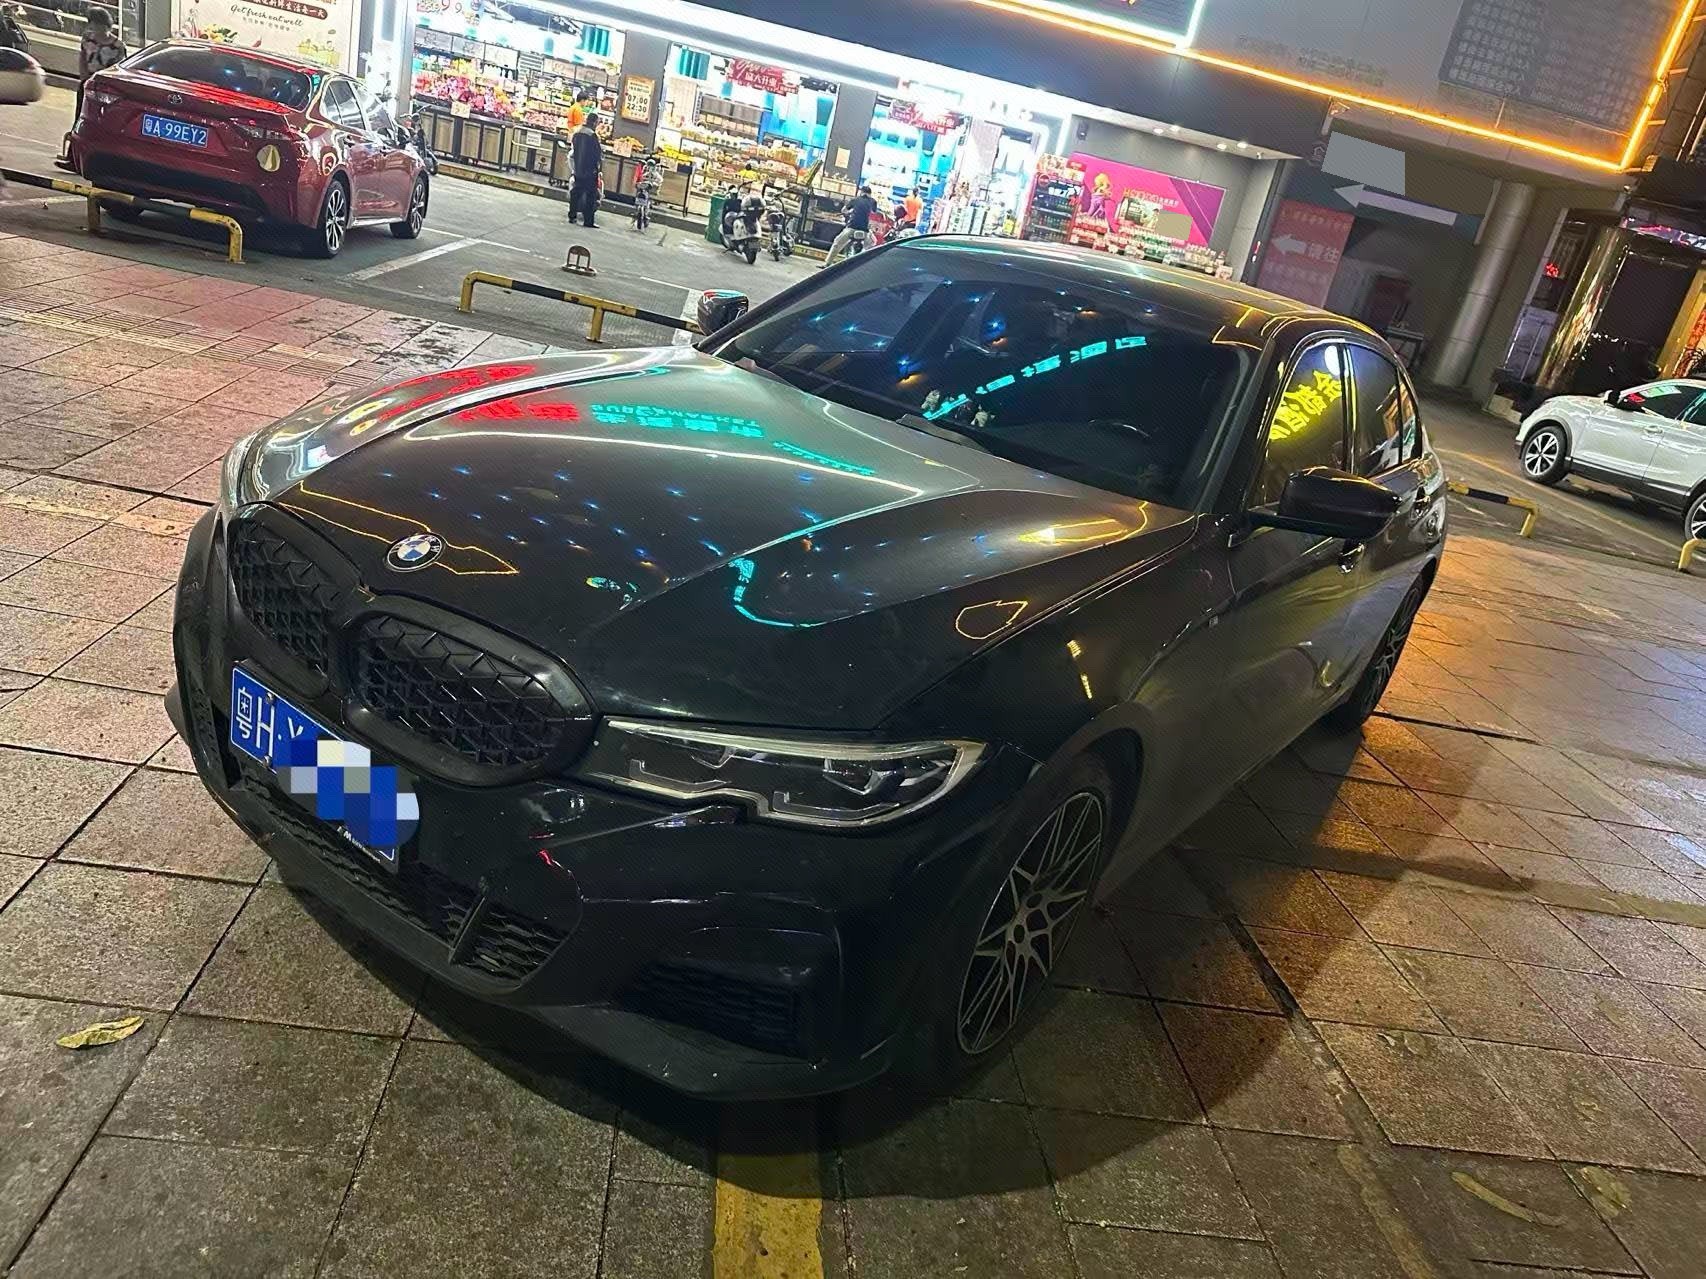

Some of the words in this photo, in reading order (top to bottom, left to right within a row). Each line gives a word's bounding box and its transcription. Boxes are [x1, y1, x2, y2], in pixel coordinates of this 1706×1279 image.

[246, 7, 267, 19] fresh
[282, 18, 303, 27] well
[626, 103, 647, 113] 22:30
